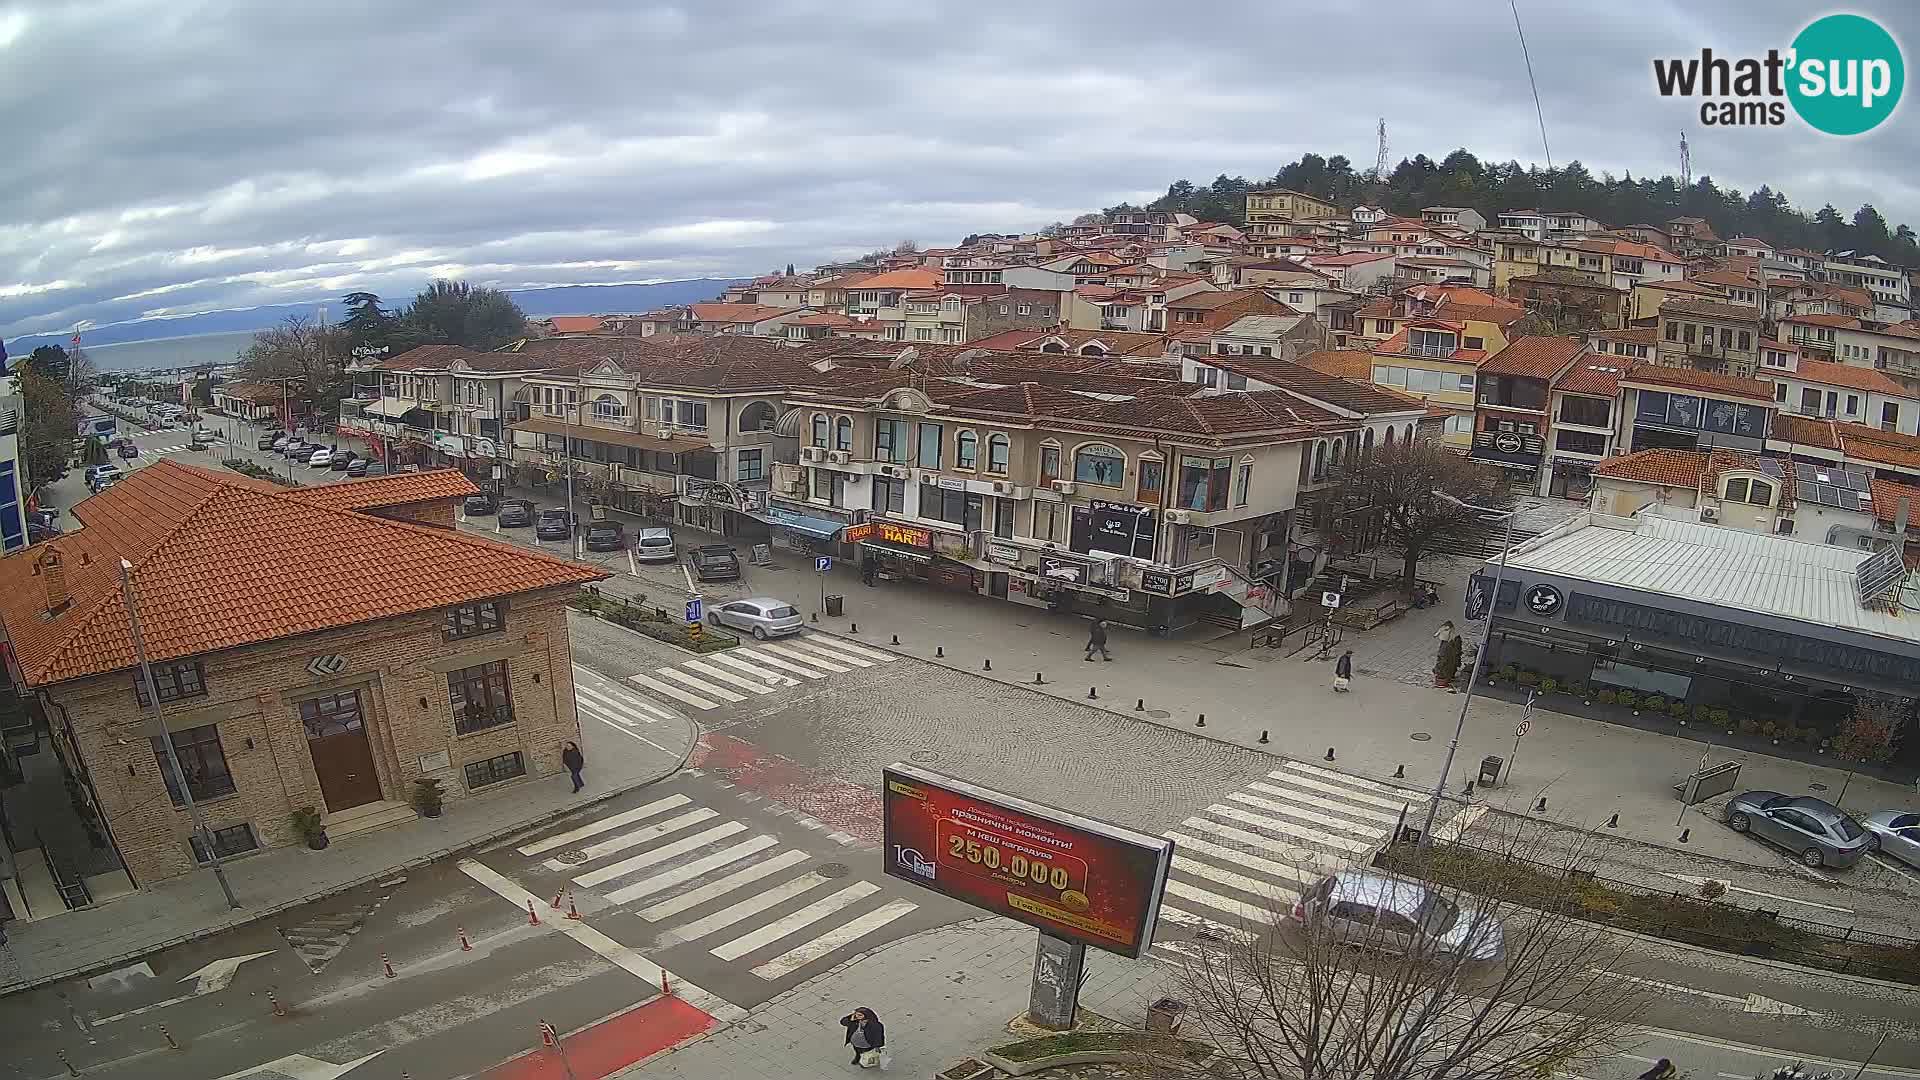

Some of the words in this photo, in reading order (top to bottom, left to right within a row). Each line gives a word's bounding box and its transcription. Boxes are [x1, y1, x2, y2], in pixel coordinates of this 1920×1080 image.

[852, 527, 872, 538] HARI
[884, 529, 917, 546] HARI
[819, 558, 827, 570] P
[951, 808, 1013, 832] празнични
[1015, 828, 1073, 850] моменти!
[1001, 840, 1053, 860] наградува
[949, 834, 1068, 890] 250.000
[990, 871, 1028, 887] денари
[1022, 902, 1034, 912] од
[1033, 905, 1045, 914] 10
[1084, 923, 1124, 940] награди
